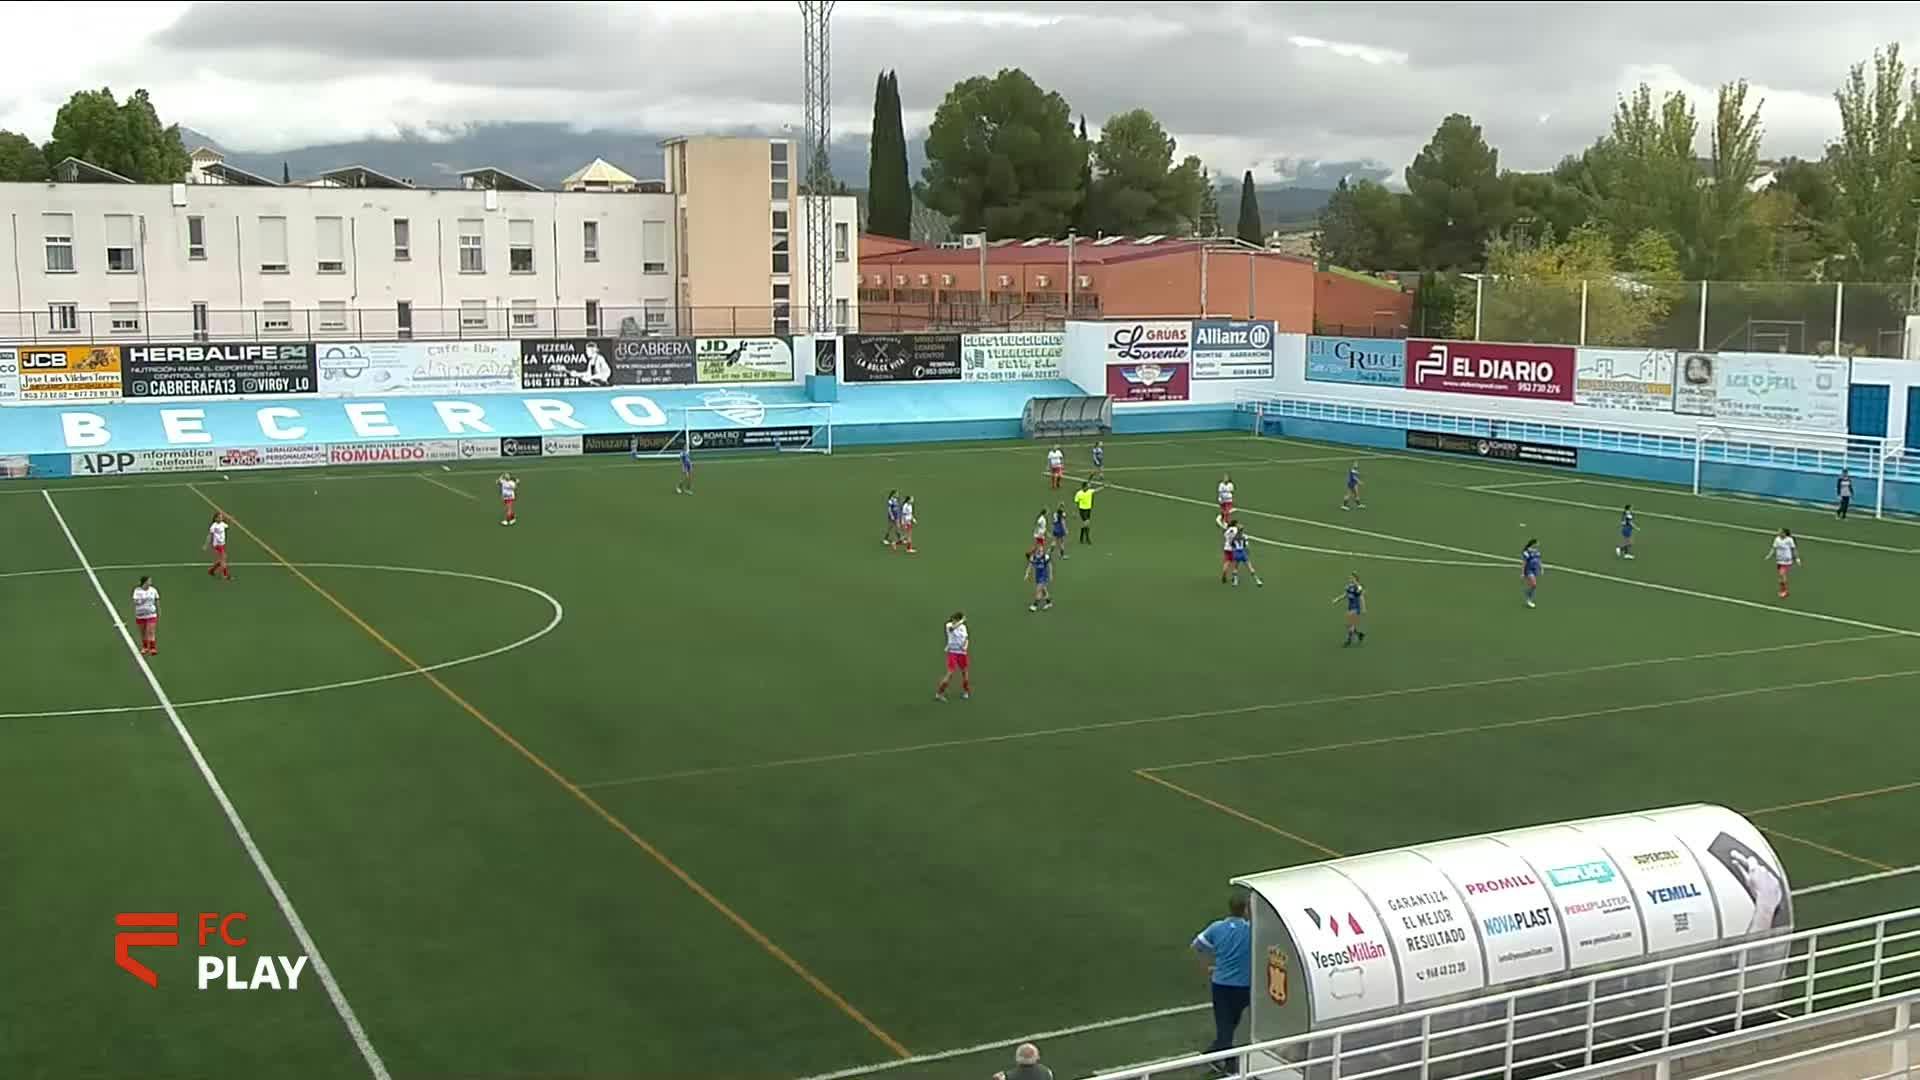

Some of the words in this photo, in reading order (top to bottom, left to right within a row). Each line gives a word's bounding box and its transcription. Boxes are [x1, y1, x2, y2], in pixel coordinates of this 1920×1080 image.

[701, 340, 729, 352] JD
[963, 336, 1064, 347] CONSTRUCCIONES
[1196, 328, 1248, 345] Allianz
[23, 353, 67, 367] JCB
[130, 346, 278, 362] HERBALIFE
[523, 354, 538, 365] LA
[541, 353, 588, 364] TAHONA
[1334, 342, 1403, 370] CRUCE
[1452, 357, 1475, 377] EL
[1478, 359, 1554, 382] DIARIO
[151, 379, 237, 396] CABRERAFA13
[258, 378, 310, 392] VIRGY_LO
[60, 395, 669, 448] BECERRO
[703, 431, 740, 440] ROMERO
[83, 452, 136, 474] APP
[331, 447, 425, 462] ROMUALDO
[1465, 873, 1536, 896] PROMILL
[1646, 882, 1703, 905] YEMILL
[1387, 889, 1449, 911] GARANTIZA
[1402, 915, 1417, 930] EL
[1416, 908, 1454, 928] MEJOR
[1483, 906, 1552, 937] NOVAPLAST
[1405, 927, 1467, 952] RESULTADO
[1311, 941, 1386, 969] YesosMillán
